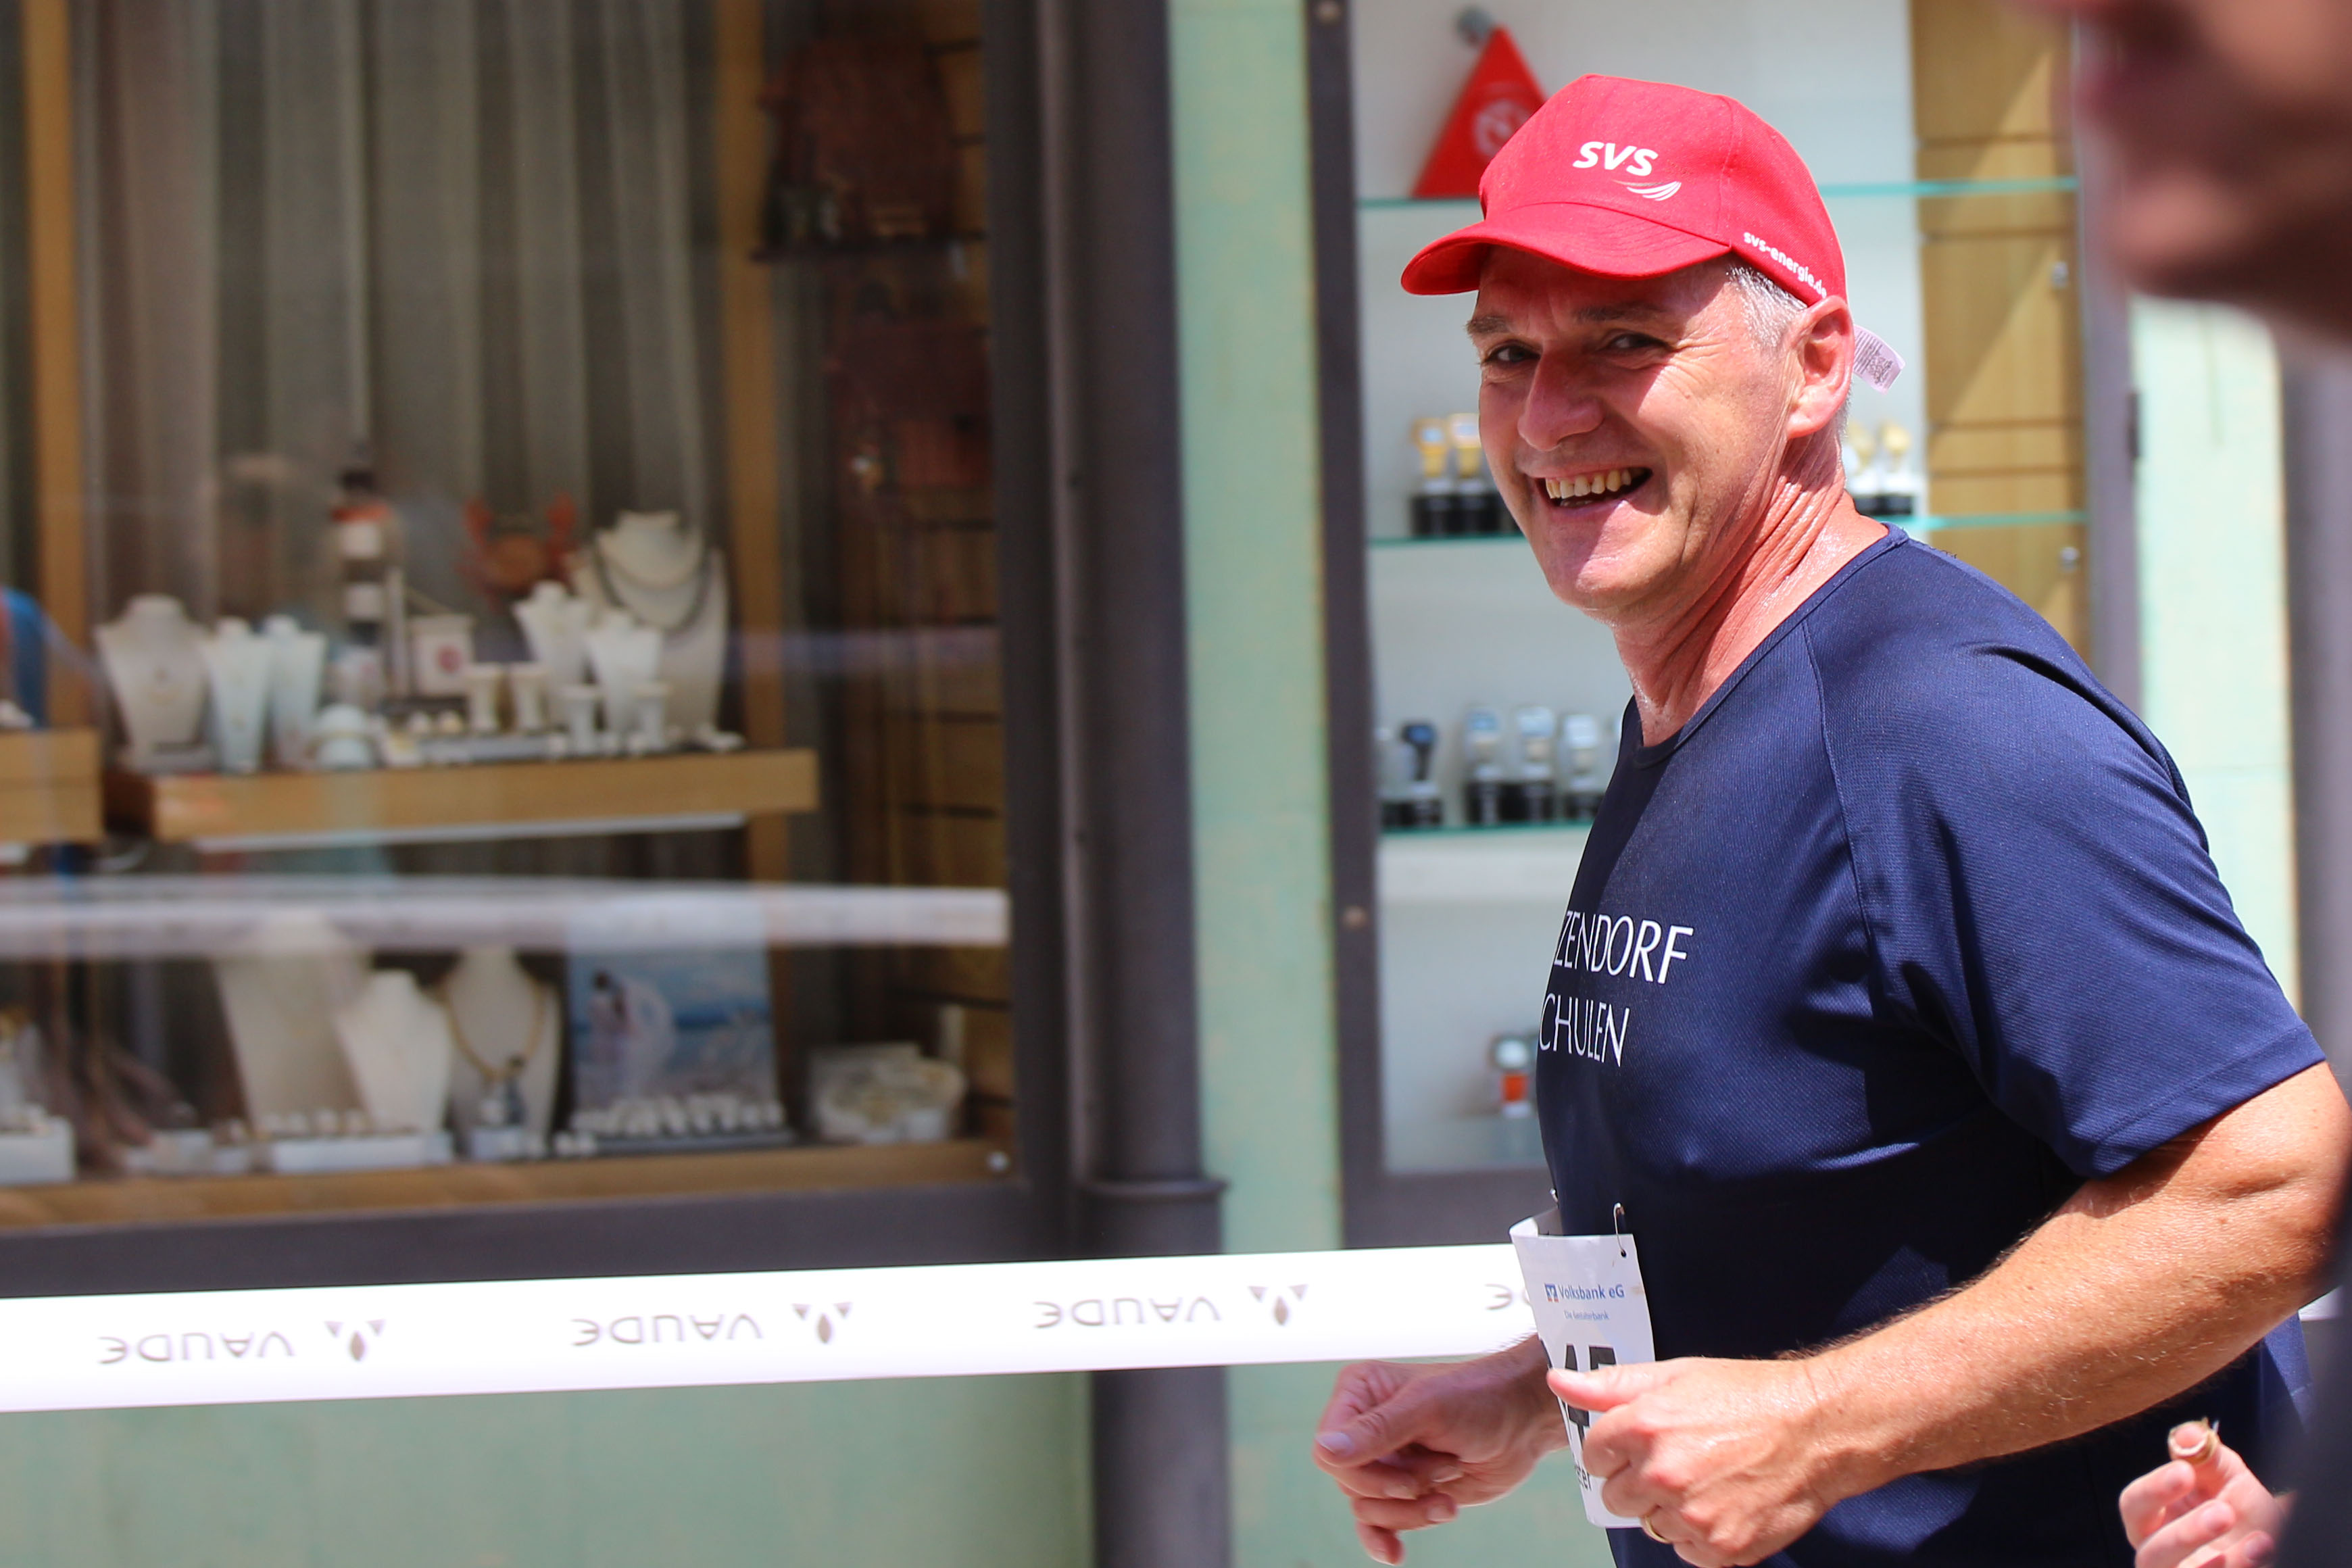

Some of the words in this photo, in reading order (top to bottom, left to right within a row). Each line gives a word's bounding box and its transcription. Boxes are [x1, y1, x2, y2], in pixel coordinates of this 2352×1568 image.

[1573, 141, 1658, 176] SVS
[1558, 1283, 1606, 1300] Volksbank
[1609, 1283, 1625, 1298] eG
[1033, 1296, 1222, 1329] VAUDE
[571, 1313, 763, 1348] VAUDE
[97, 1331, 295, 1365] VAUDE
